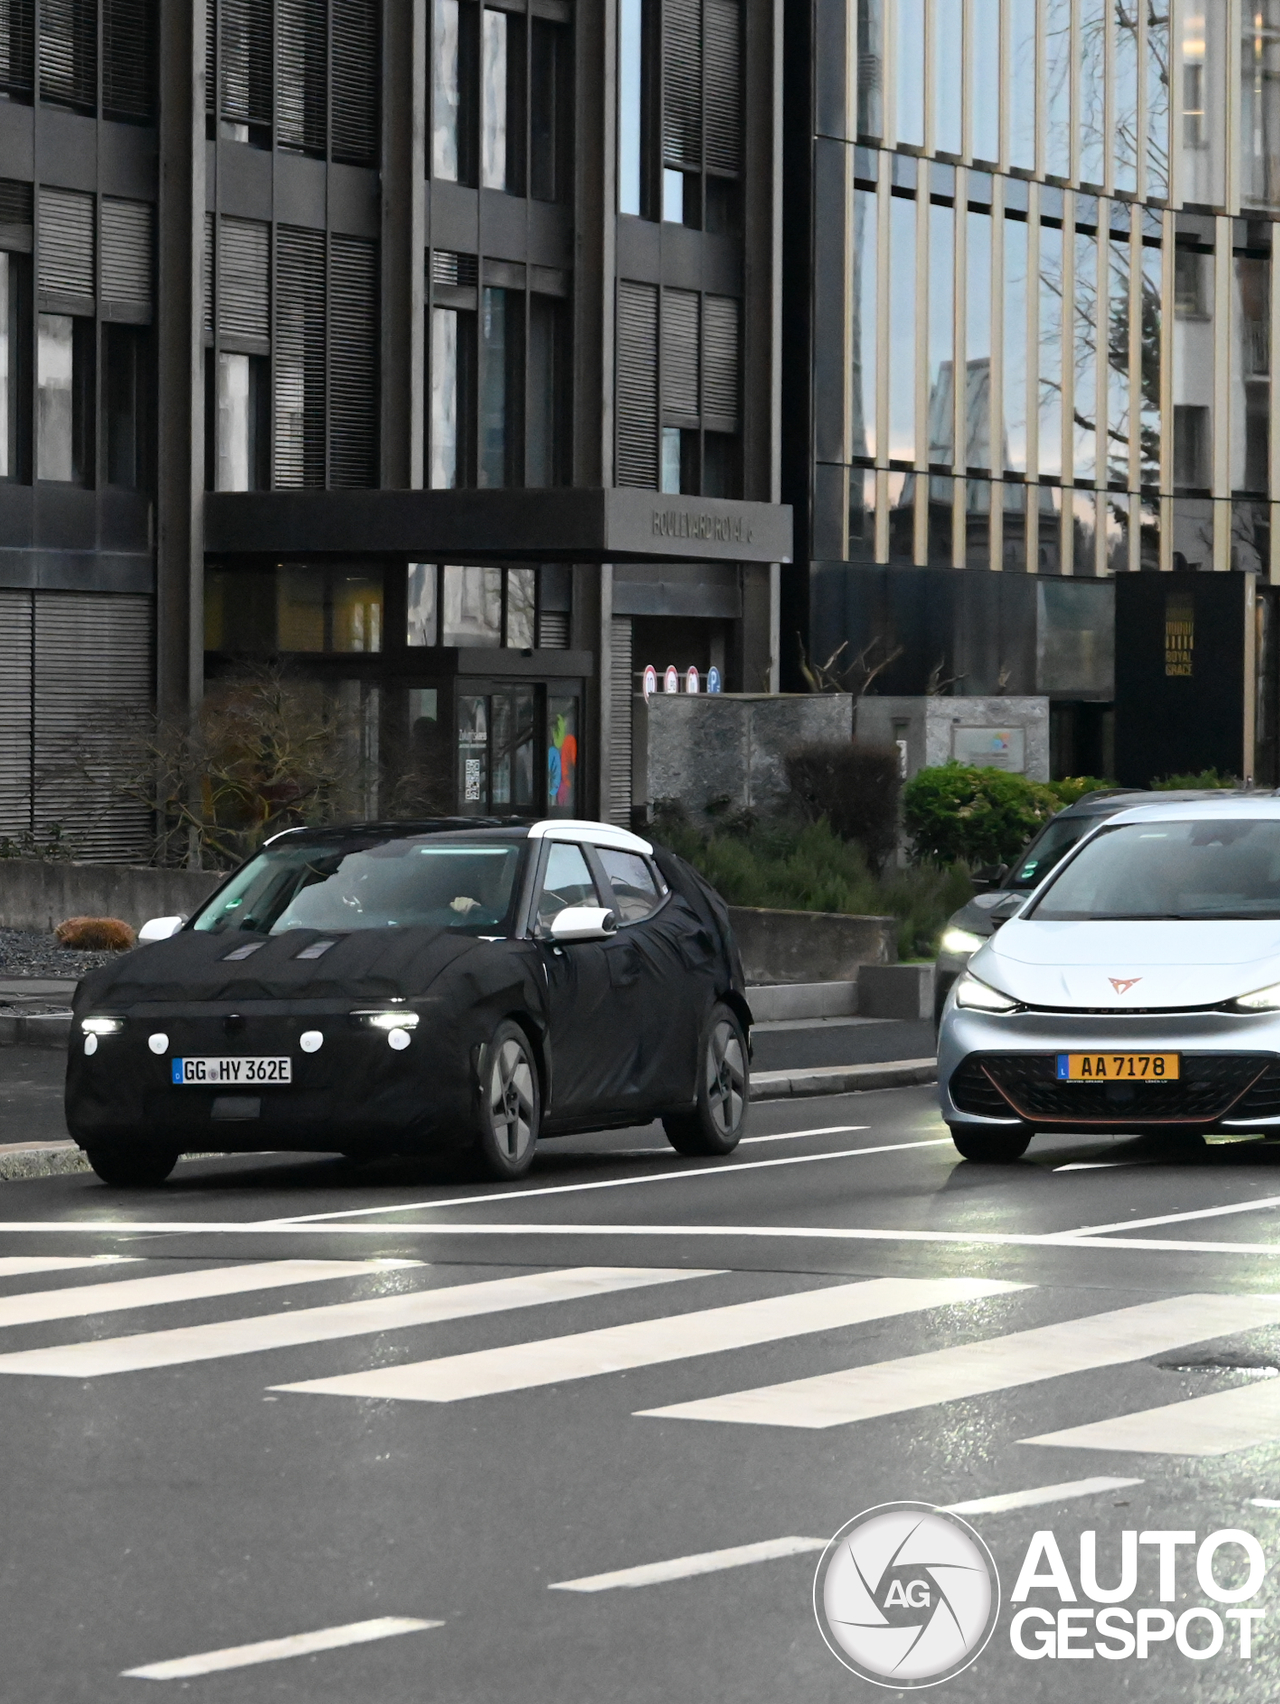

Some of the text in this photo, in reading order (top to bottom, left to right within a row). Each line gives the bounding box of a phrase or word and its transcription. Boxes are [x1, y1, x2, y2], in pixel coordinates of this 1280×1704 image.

[652, 509, 711, 539] BOULEVARD
[713, 514, 743, 542] ROYAL
[1165, 650, 1192, 662] ROYAL
[1165, 663, 1192, 676] GRACE
[710, 671, 717, 692] P
[184, 1060, 206, 1080] GG
[219, 1060, 241, 1080] HY
[245, 1060, 289, 1080] 362E
[1060, 1057, 1165, 1076] L AA 7178
